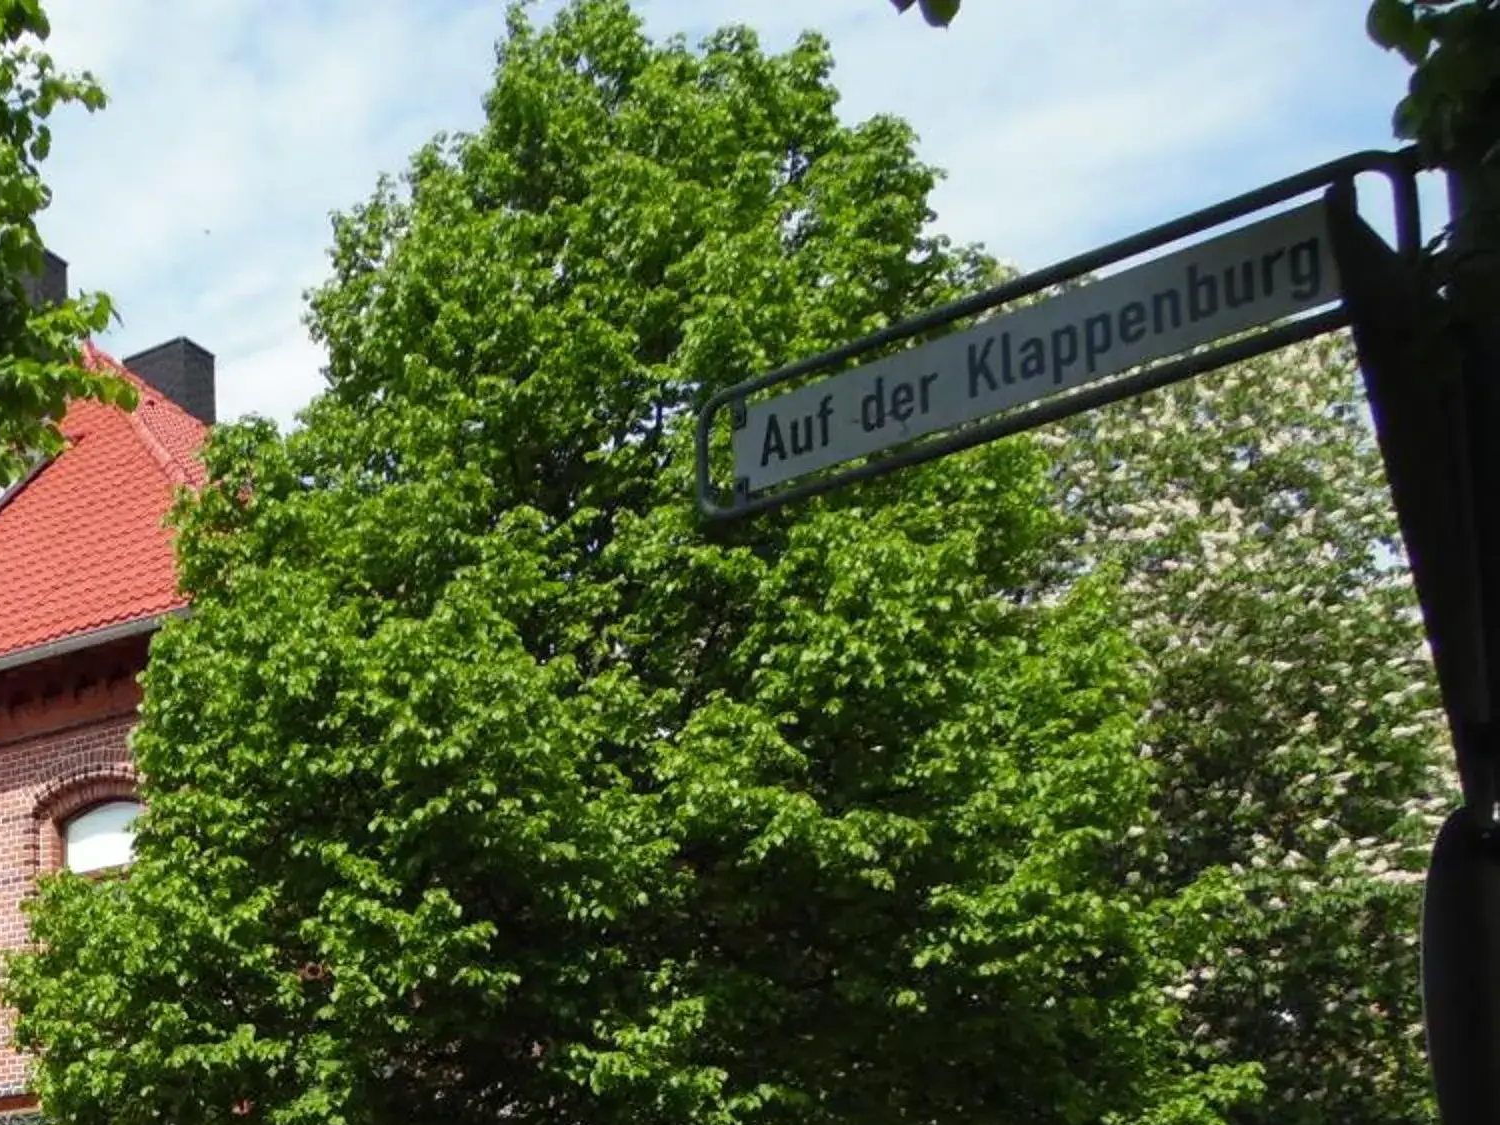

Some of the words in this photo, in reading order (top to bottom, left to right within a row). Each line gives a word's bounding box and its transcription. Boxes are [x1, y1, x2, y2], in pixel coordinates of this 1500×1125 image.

[759, 393, 835, 467] Auf
[861, 372, 939, 432] der
[966, 236, 1321, 400] Klappenburg
